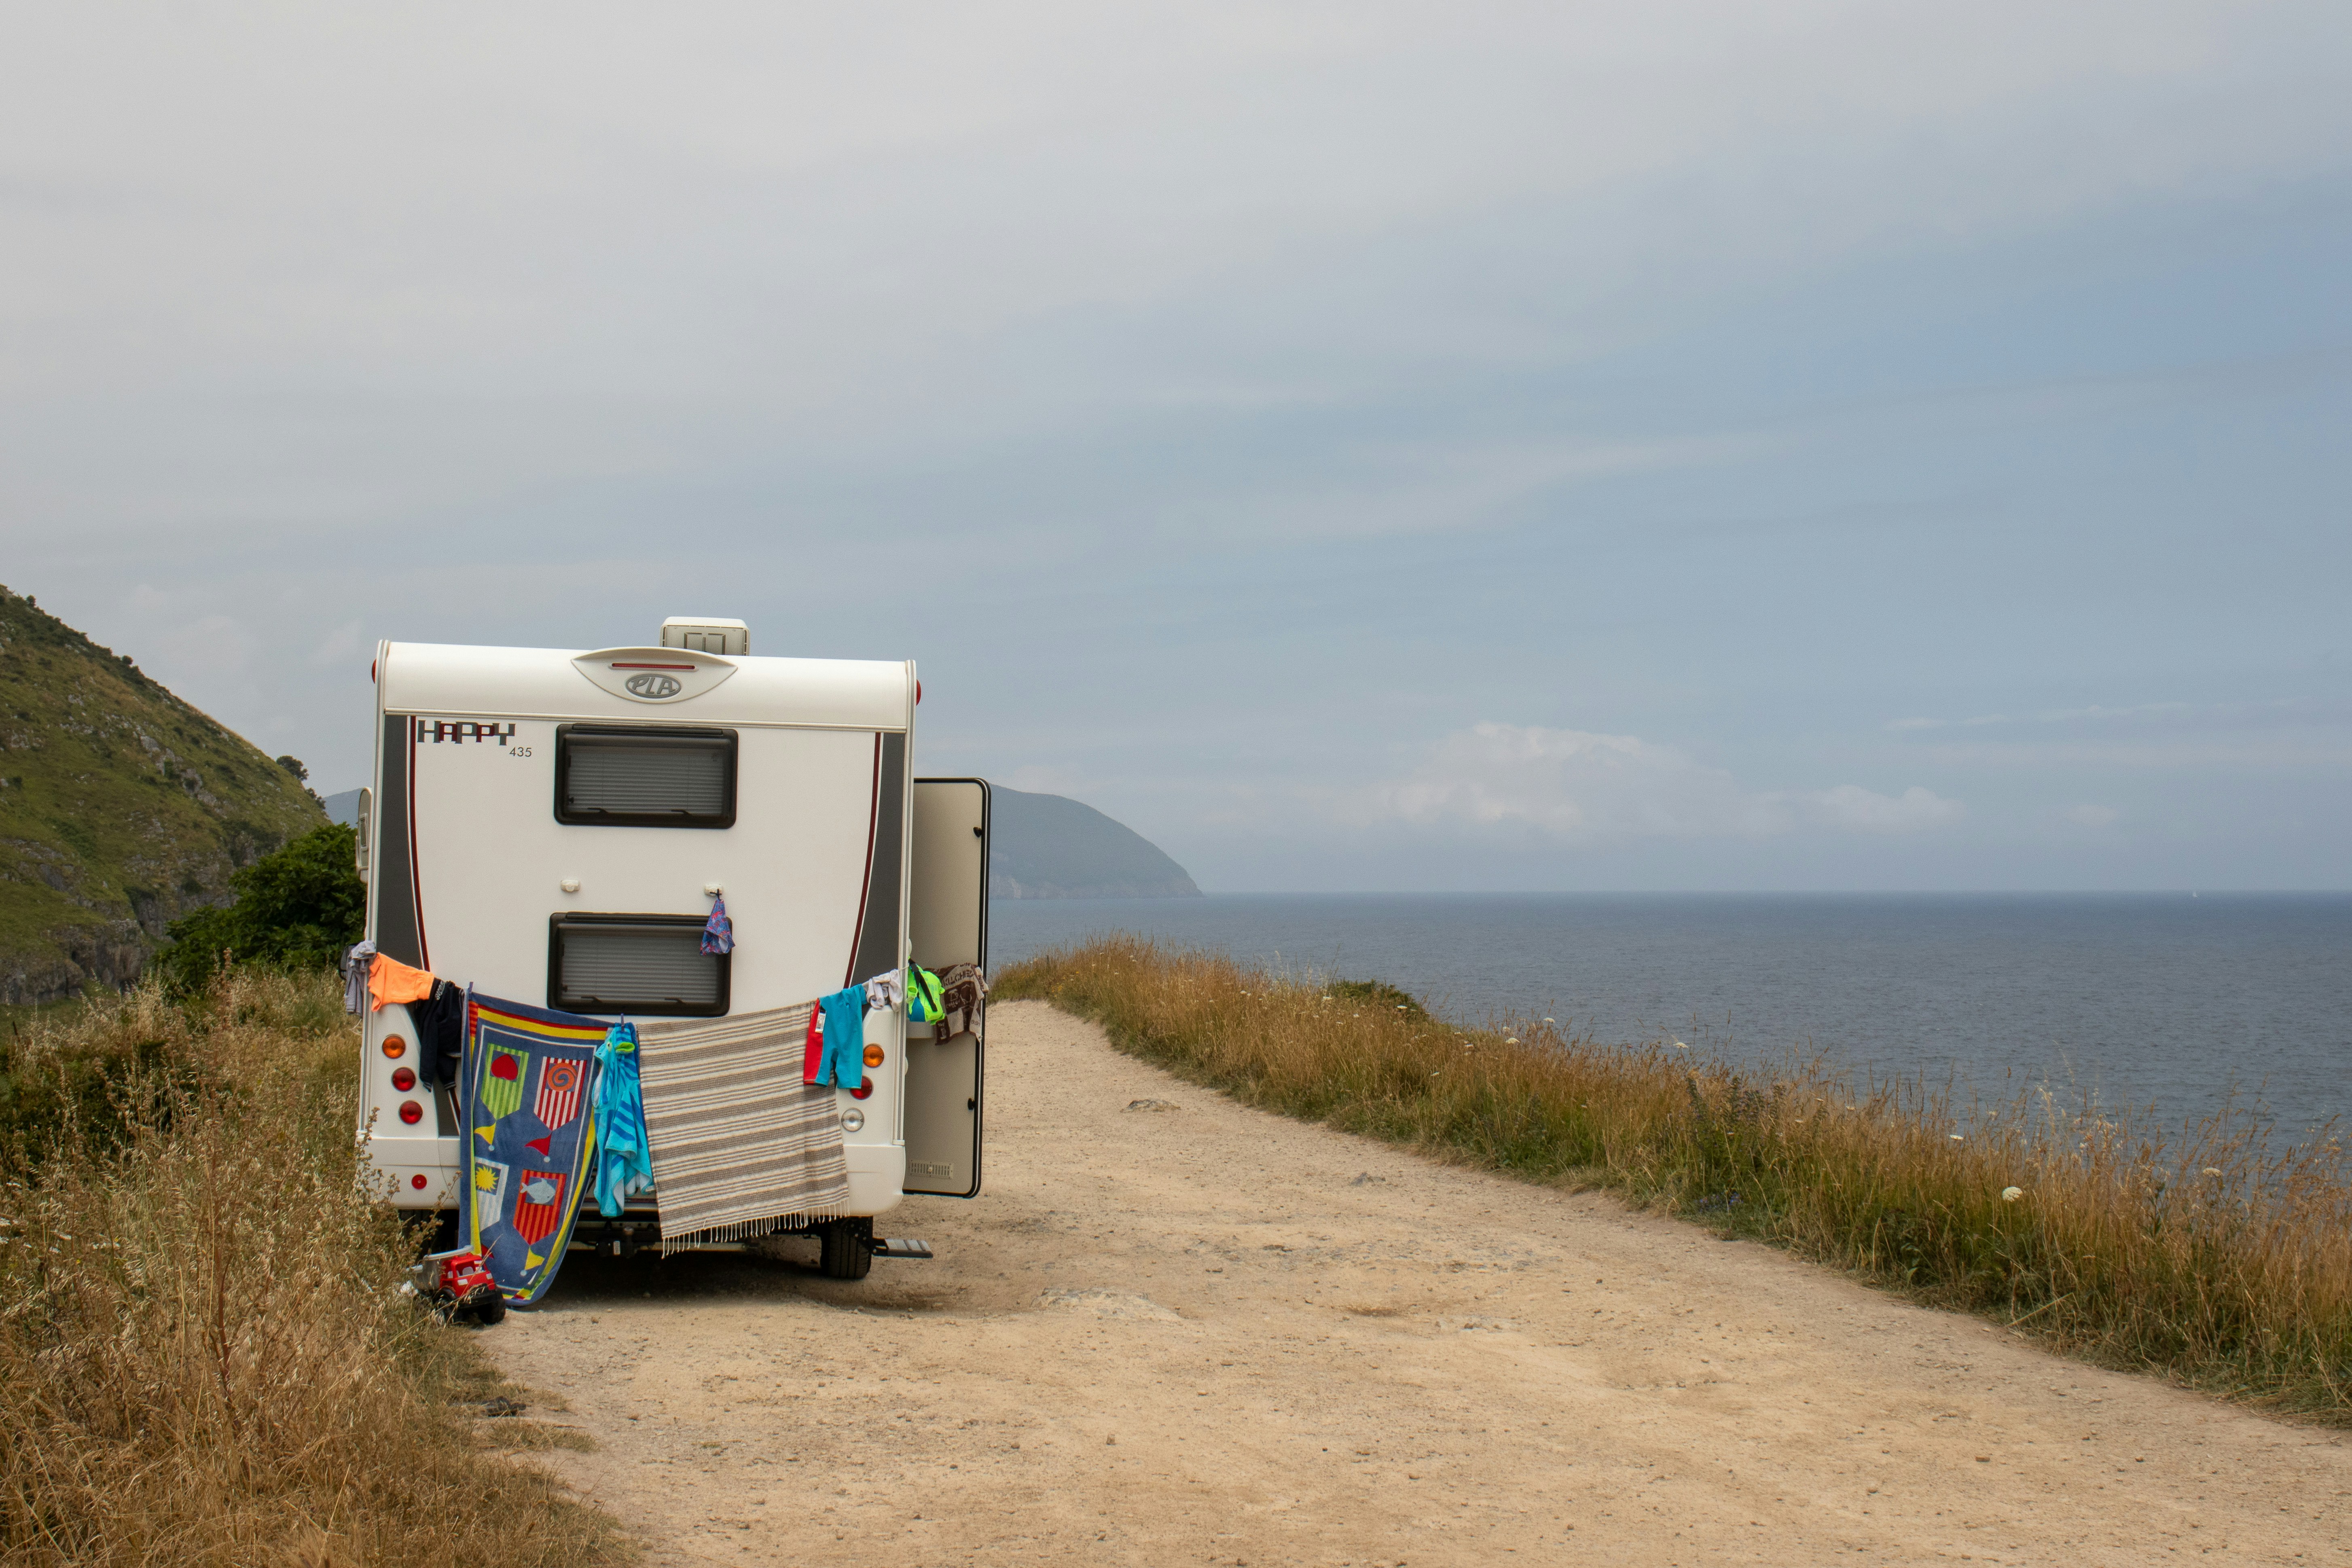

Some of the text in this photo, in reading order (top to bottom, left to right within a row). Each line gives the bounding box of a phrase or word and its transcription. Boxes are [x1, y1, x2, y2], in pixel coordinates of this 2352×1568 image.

[631, 677, 676, 694] PLA
[417, 720, 516, 745] HAPPY
[509, 747, 532, 757] 435
